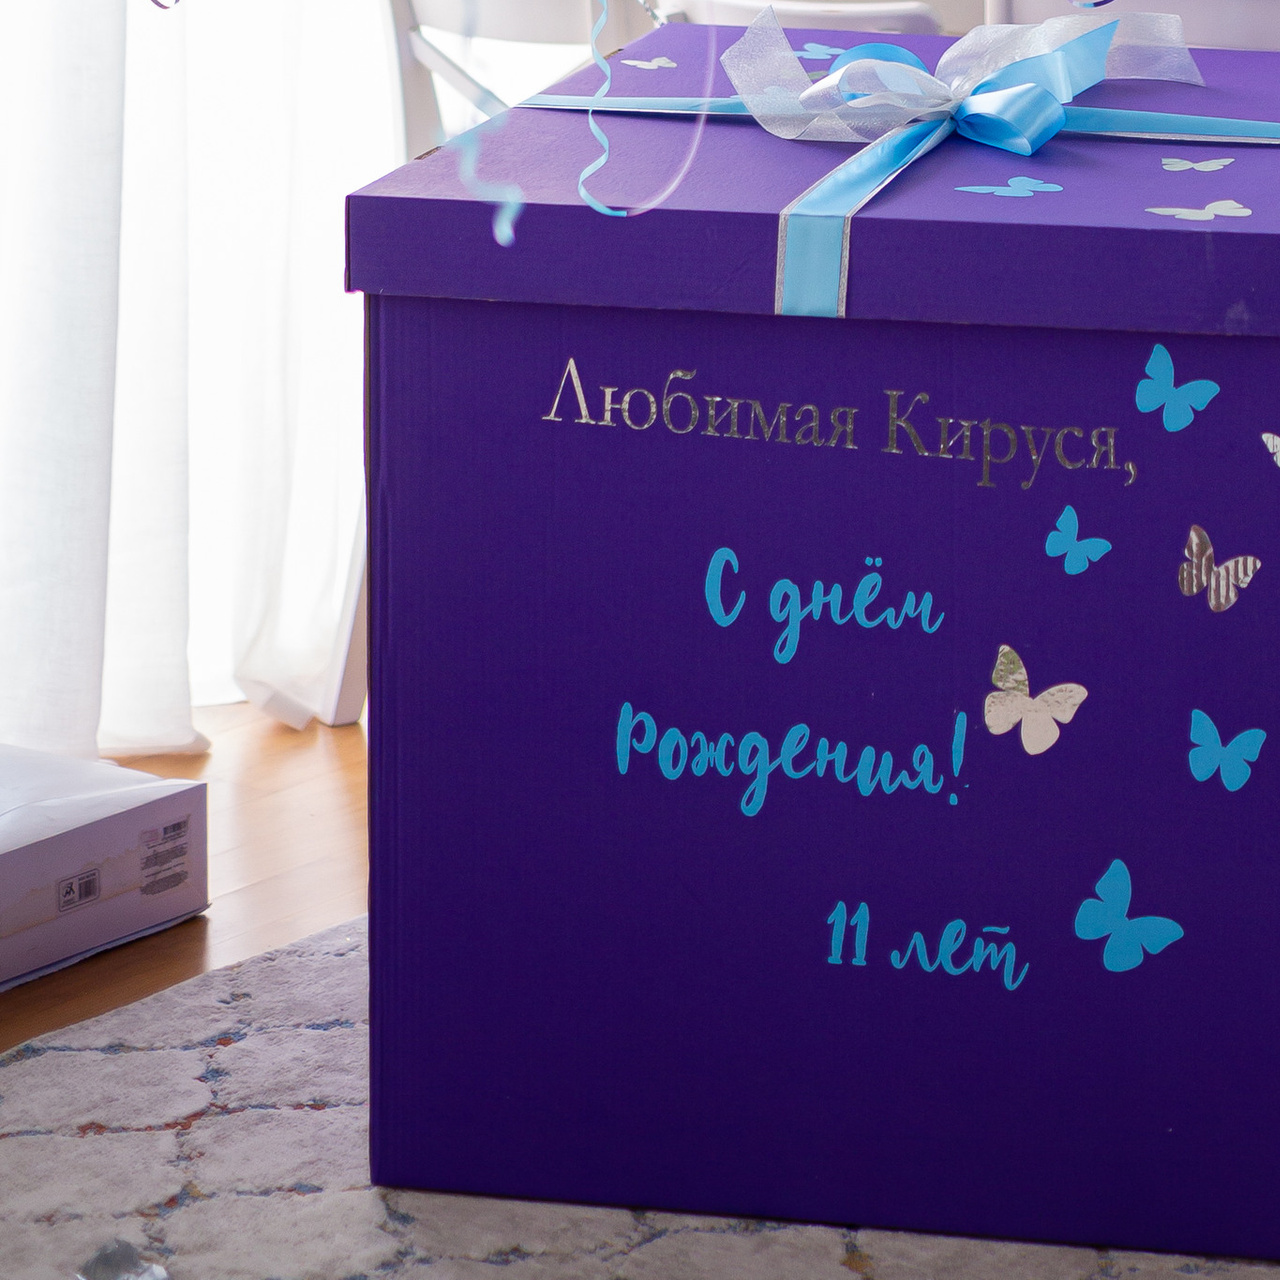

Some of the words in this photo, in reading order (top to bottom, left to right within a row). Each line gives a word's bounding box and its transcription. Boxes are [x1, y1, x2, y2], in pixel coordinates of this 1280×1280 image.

[541, 356, 860, 450] Любимая
[881, 387, 1138, 490] Кируся,
[705, 547, 746, 627] С
[769, 557, 945, 664] днём
[616, 701, 969, 817] Рождения!
[827, 900, 870, 966] 11
[890, 918, 1030, 991] лет
